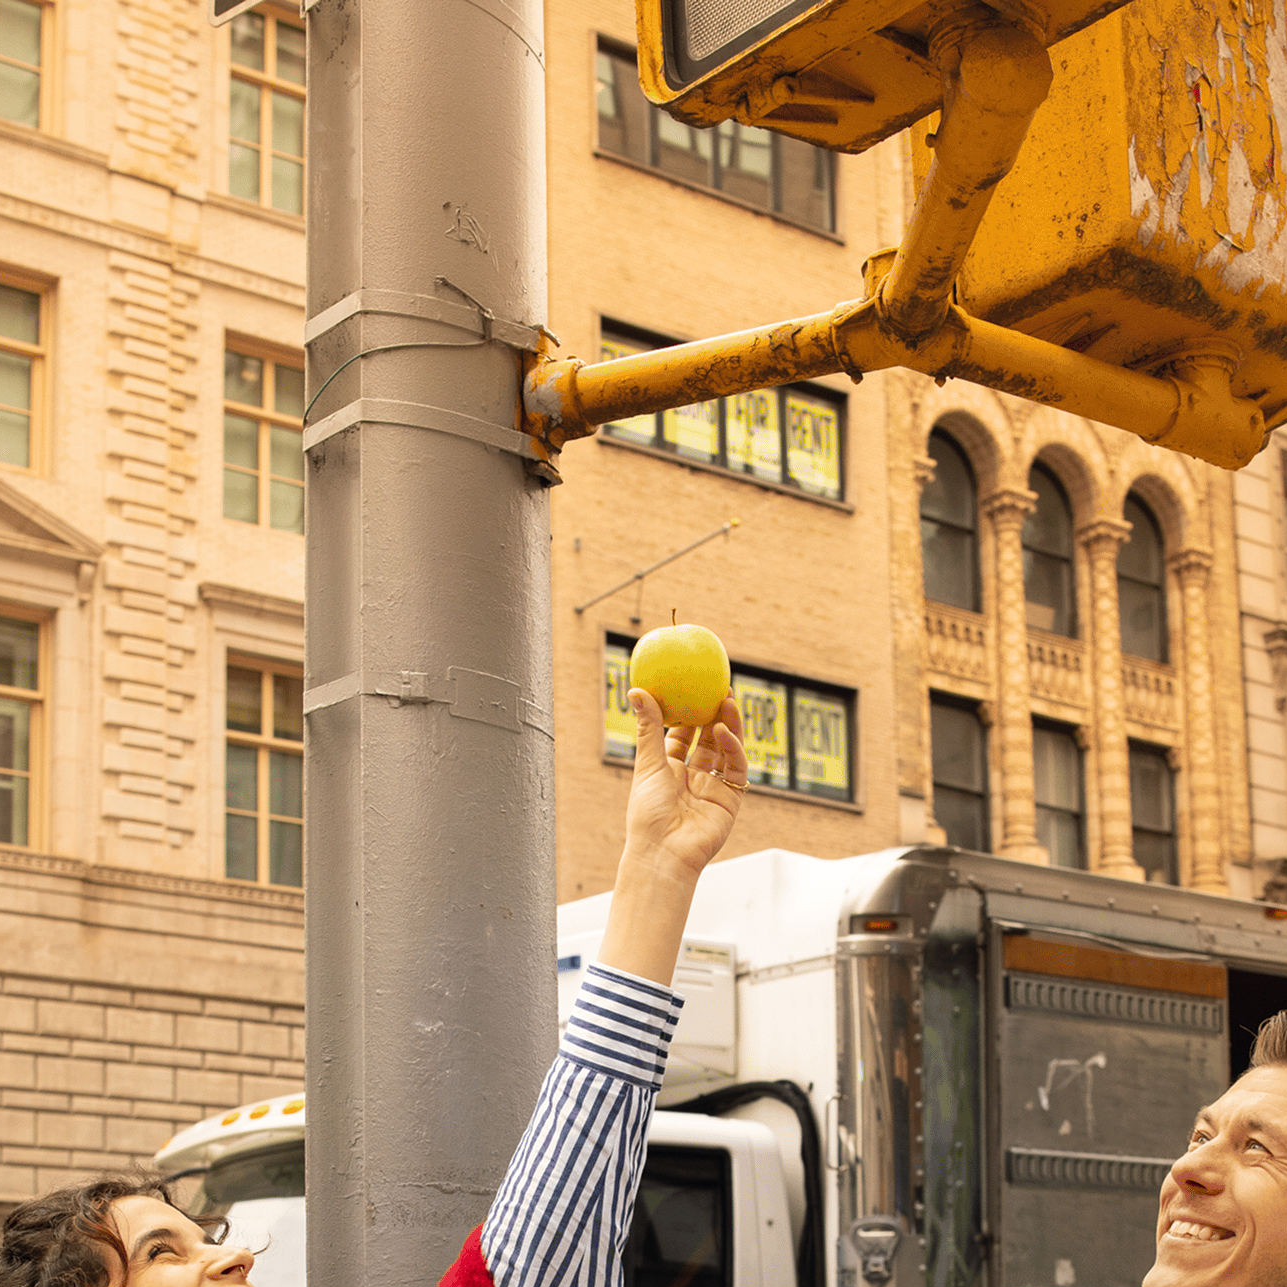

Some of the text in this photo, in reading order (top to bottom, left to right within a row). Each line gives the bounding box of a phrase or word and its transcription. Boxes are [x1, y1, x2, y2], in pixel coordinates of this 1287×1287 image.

[787, 404, 832, 458] RENT
[742, 692, 779, 744] FOR
[797, 703, 842, 758] RENT
